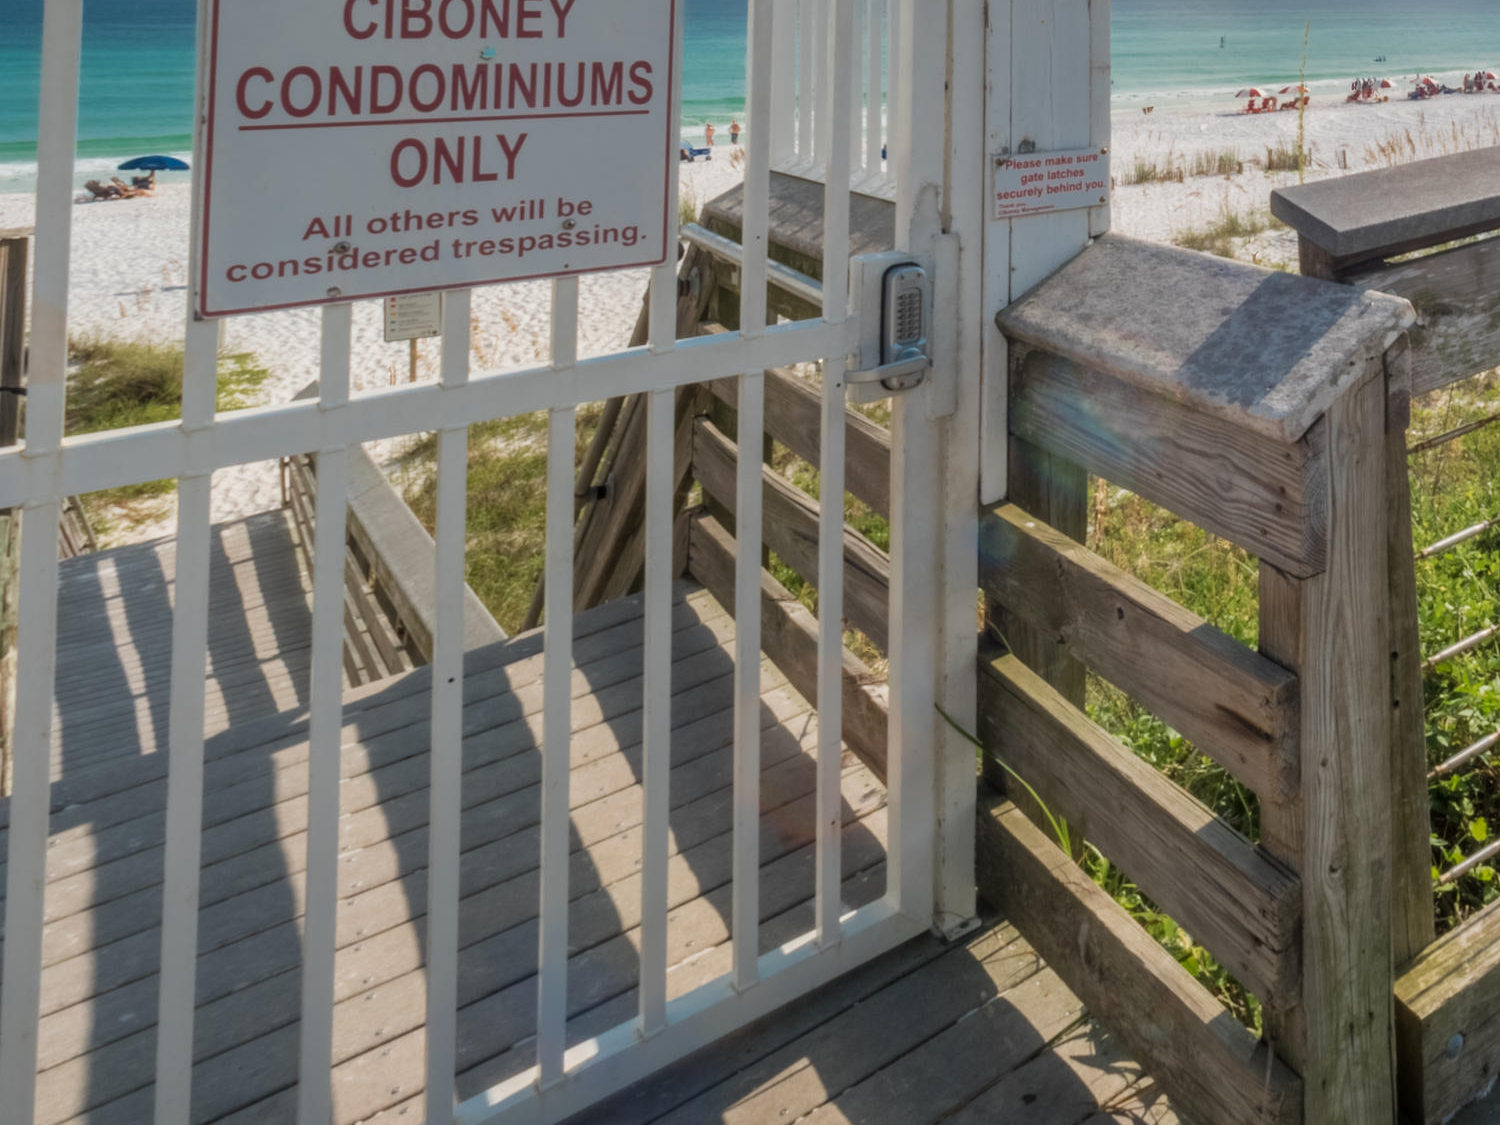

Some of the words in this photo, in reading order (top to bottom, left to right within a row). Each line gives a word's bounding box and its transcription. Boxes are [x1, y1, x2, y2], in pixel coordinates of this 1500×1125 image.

[234, 59, 654, 120] CONDOMINIUMS
[389, 132, 528, 188] ONLY
[1005, 159, 1042, 170] Please
[1045, 155, 1073, 166] make
[1076, 154, 1098, 163] sure
[1020, 173, 1044, 185] gate
[1047, 168, 1084, 180] latches
[997, 187, 1043, 201] securely
[1046, 181, 1082, 195] behind
[1085, 181, 1106, 192] you.
[303, 214, 353, 241] All
[366, 209, 479, 235] others
[491, 199, 545, 223] will
[557, 197, 593, 217] be
[225, 238, 441, 283] considered
[452, 224, 649, 261] trespassing.
